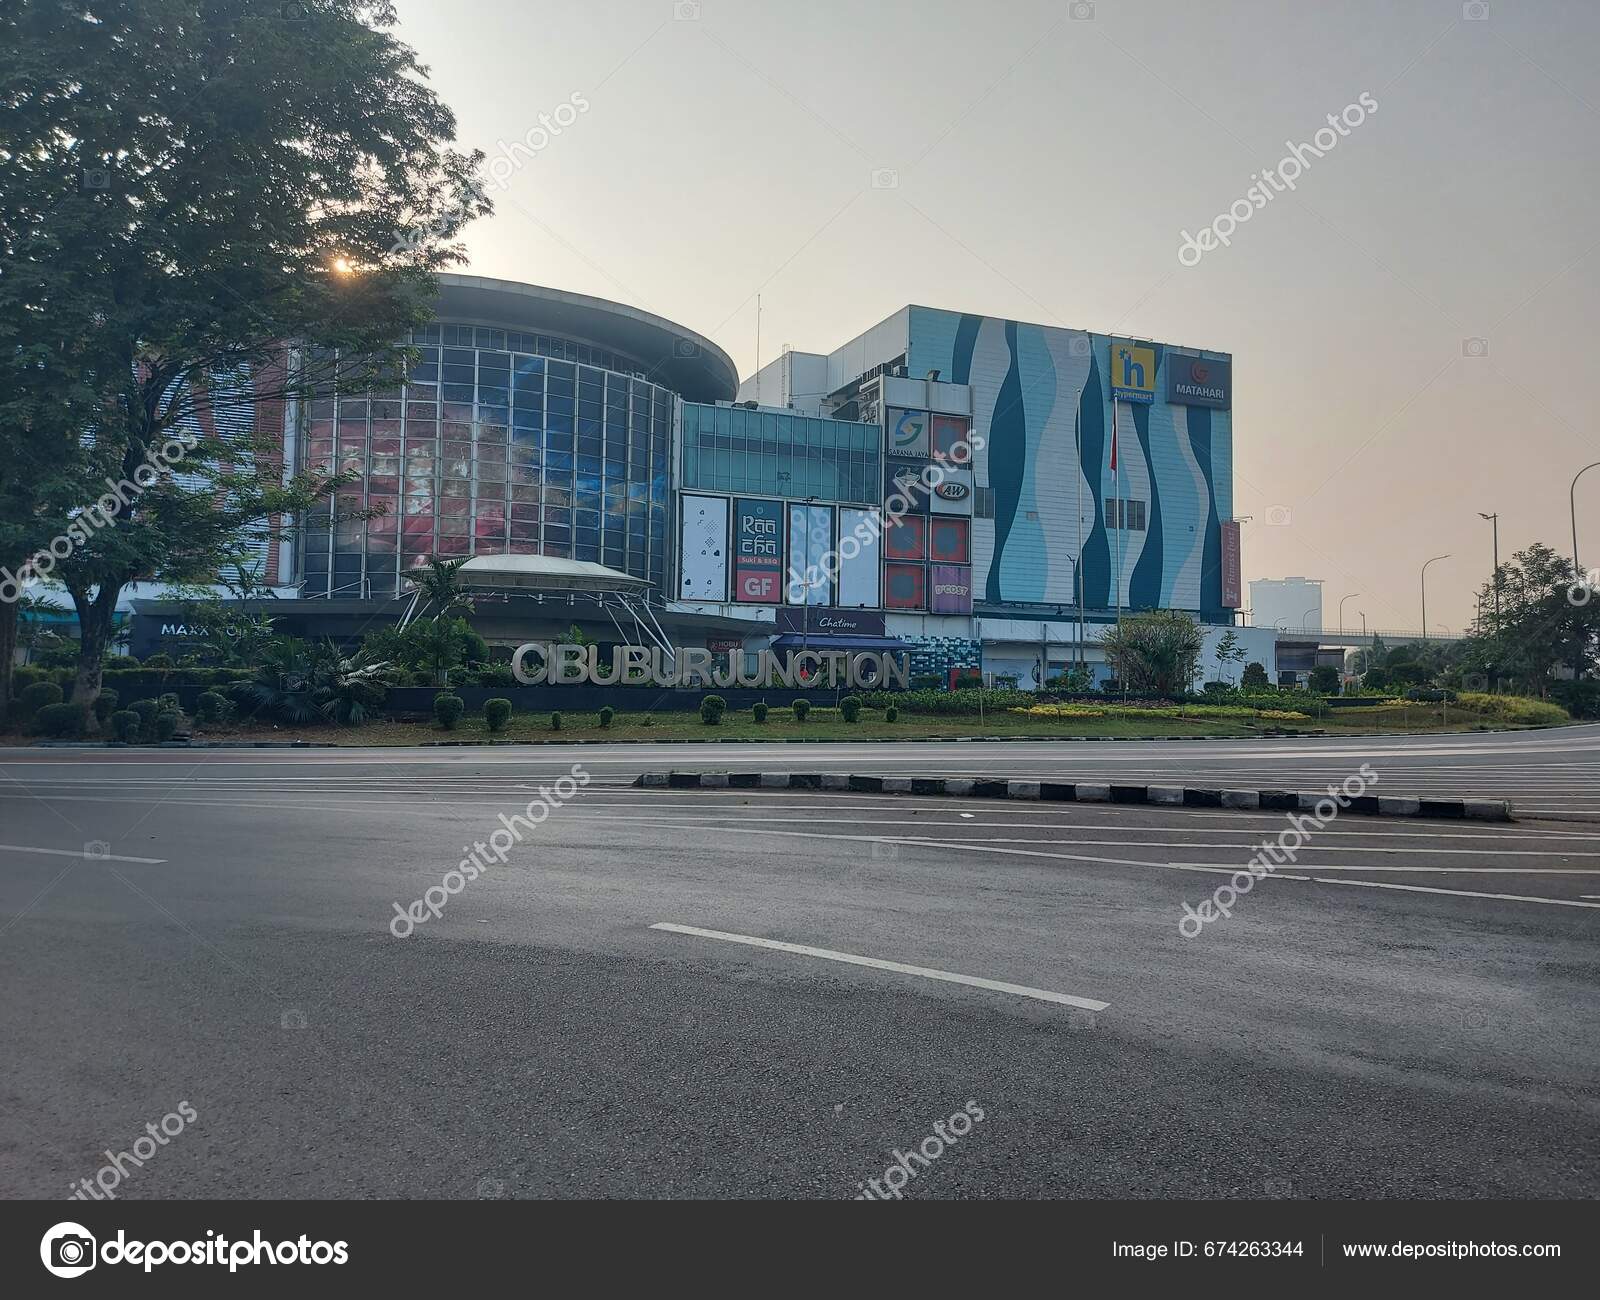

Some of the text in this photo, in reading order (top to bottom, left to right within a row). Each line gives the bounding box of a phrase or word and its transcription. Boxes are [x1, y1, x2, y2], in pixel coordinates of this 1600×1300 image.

[1176, 384, 1224, 399] MATAHARI
[888, 448, 913, 457] SARANA
[742, 515, 776, 535] Raa
[744, 577, 773, 596] GF
[161, 623, 209, 636] MAXX
[819, 617, 857, 629] Chatime
[511, 643, 911, 690] CIBUBUR JUNCTION
